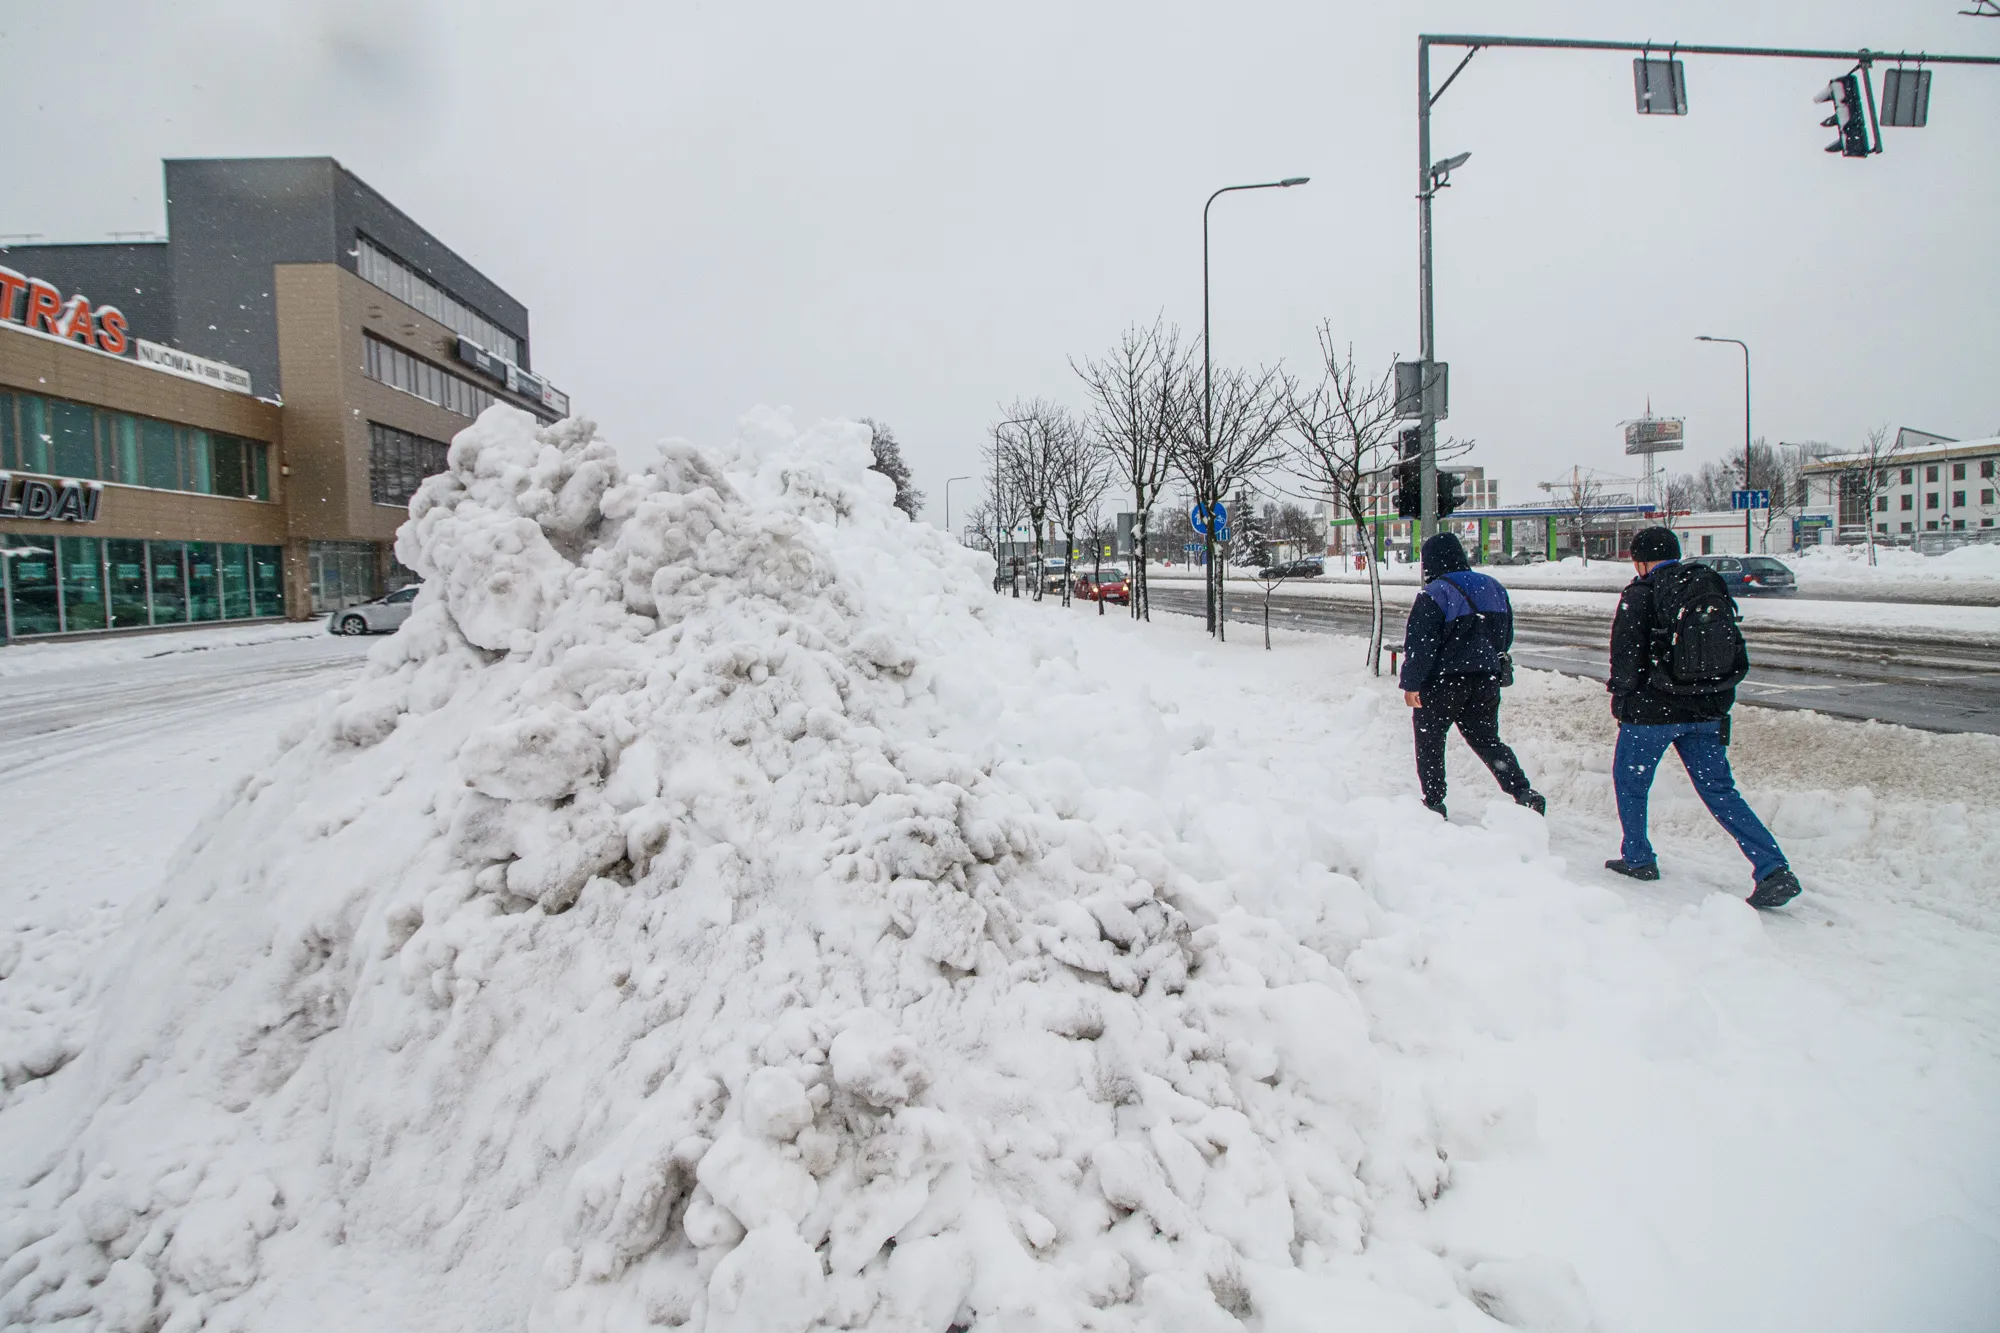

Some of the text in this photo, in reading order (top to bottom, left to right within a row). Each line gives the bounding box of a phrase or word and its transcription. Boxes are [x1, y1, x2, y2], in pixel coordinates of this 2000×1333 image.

[0, 270, 128, 354] TRAS
[140, 345, 195, 374] NUOMA
[0, 479, 102, 523] LDAI
